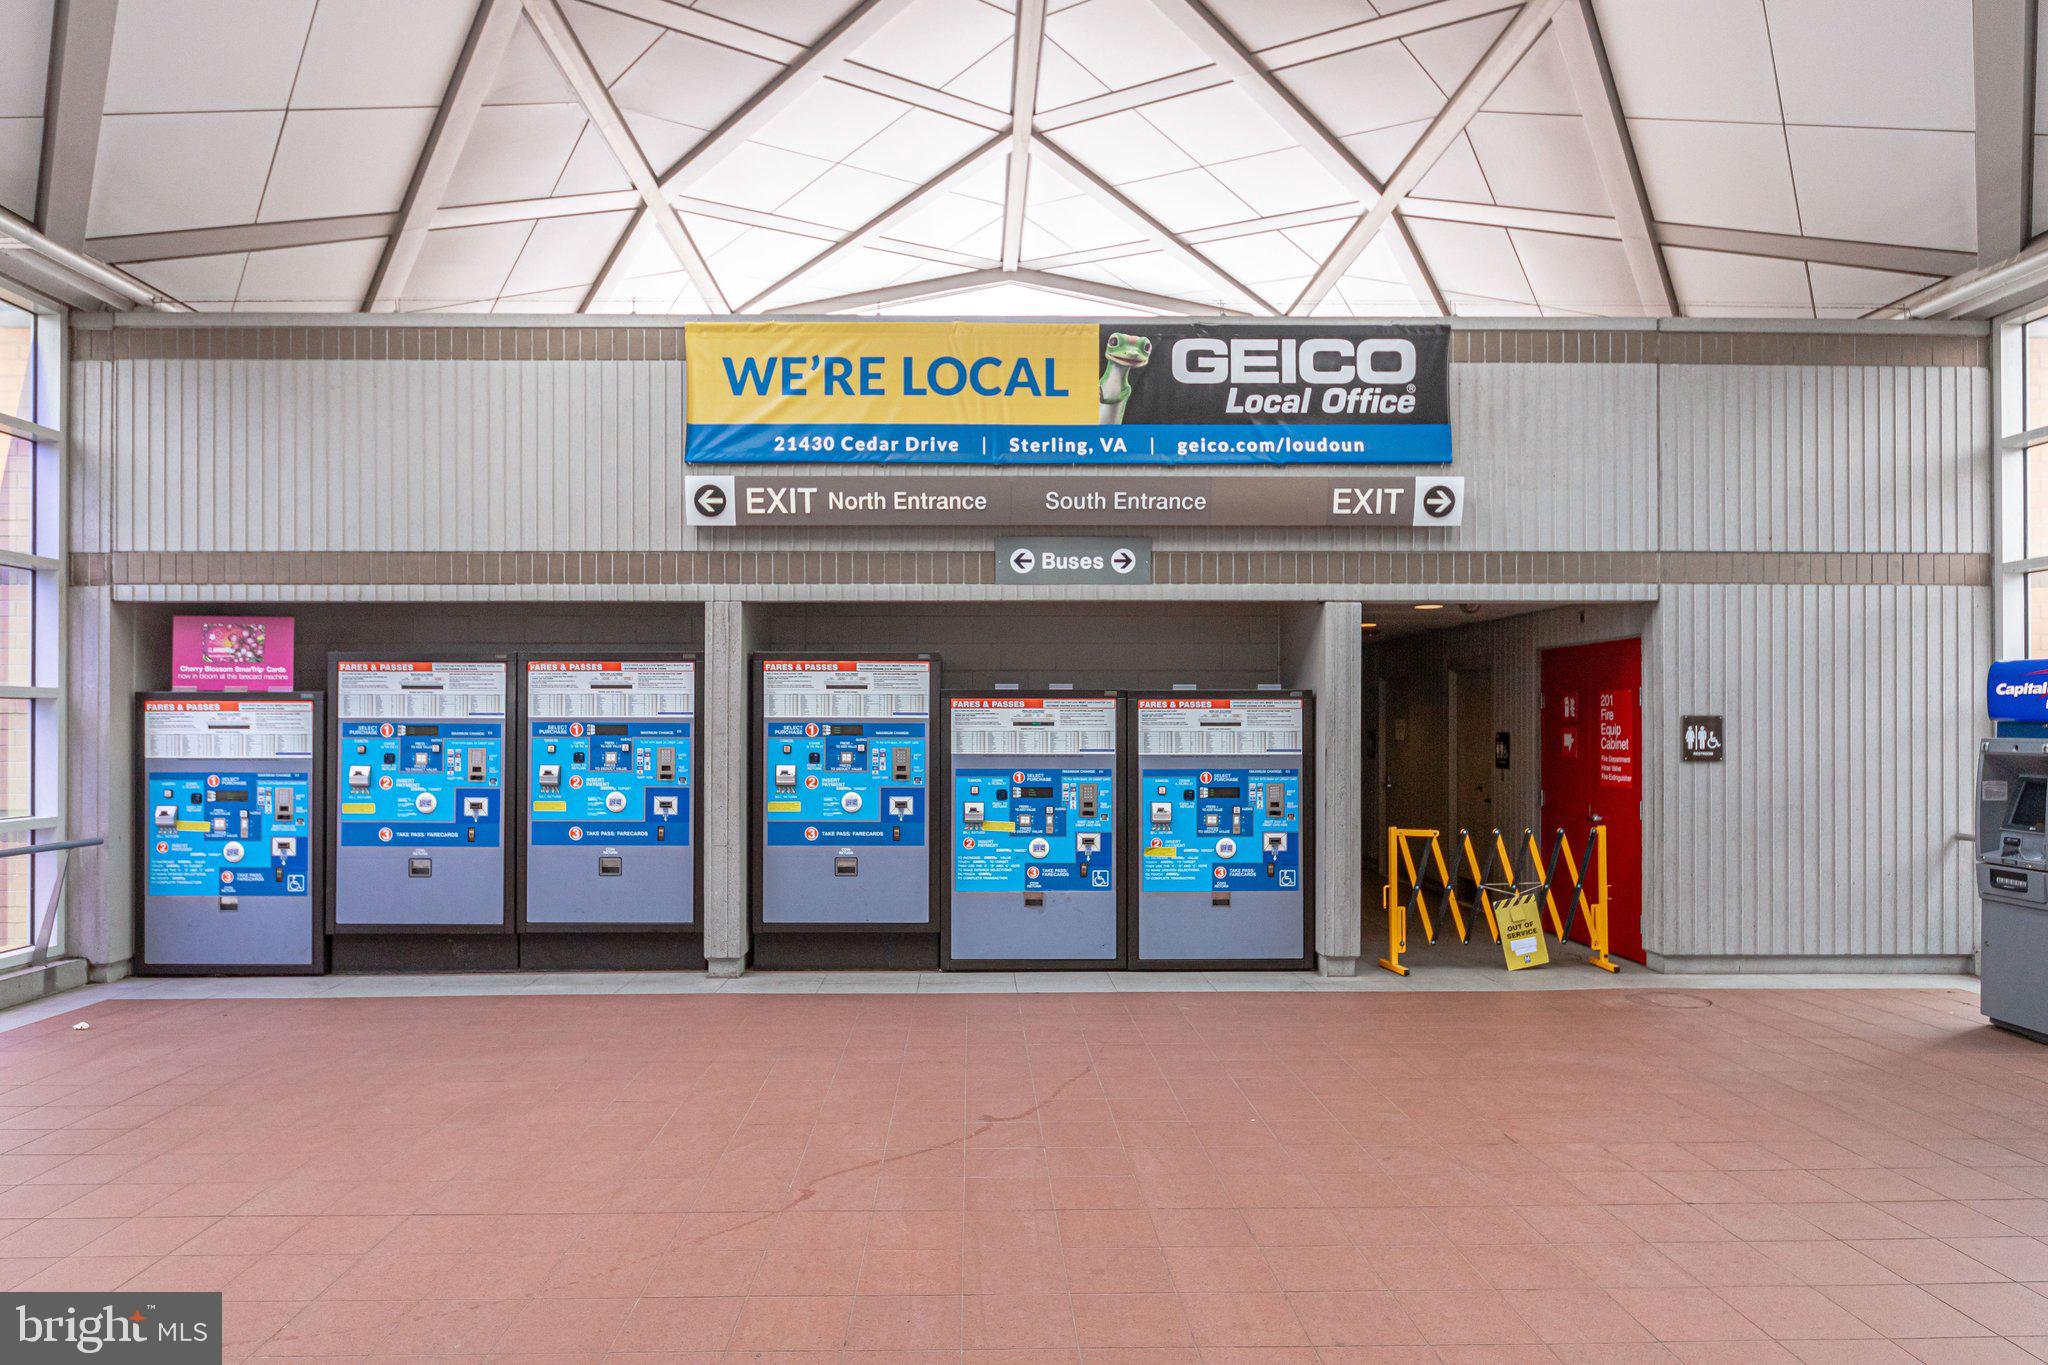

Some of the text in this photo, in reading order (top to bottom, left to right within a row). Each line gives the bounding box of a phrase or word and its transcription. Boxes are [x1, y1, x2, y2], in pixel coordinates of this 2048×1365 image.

[1171, 338, 1416, 384] GEICO
[903, 357, 1069, 397] LOCAL
[1226, 387, 1416, 414] Local Office
[774, 436, 1365, 456] 21430 Cedar Drive Sterling, VA geico.com/loudoun
[746, 487, 987, 514] EXIT North Entrance
[1045, 488, 1404, 514] South Entrance EXIT
[1042, 552, 1104, 570] Buses
[180, 665, 203, 673] Cherry
[204, 665, 233, 673] Blossom
[266, 665, 286, 673] Cards
[1996, 682, 2048, 697] Capital
[1600, 694, 1613, 707] 201
[146, 703, 221, 711] FARES & PASSES
[1601, 708, 1614, 720] Fire
[384, 726, 390, 735] 1
[574, 725, 579, 734] 1
[810, 725, 815, 735] 1
[1601, 723, 1621, 738] Equip
[1601, 737, 1629, 750] Cabinet
[211, 777, 216, 785] 1
[573, 777, 579, 786] 2
[809, 778, 815, 786] 2
[1016, 773, 1021, 782] 1
[1203, 773, 1208, 782] 1
[383, 778, 389, 787] 2
[383, 830, 389, 839] 3
[573, 829, 579, 838] 3
[809, 829, 815, 838] 3
[160, 843, 165, 851] 2
[966, 839, 972, 847] 2
[1153, 839, 1160, 847] 2
[1030, 868, 1036, 877] 3
[1217, 868, 1223, 877] 3
[225, 873, 231, 882] 3
[1507, 924, 1522, 932] OUT
[1507, 928, 1537, 939] SERVICE
